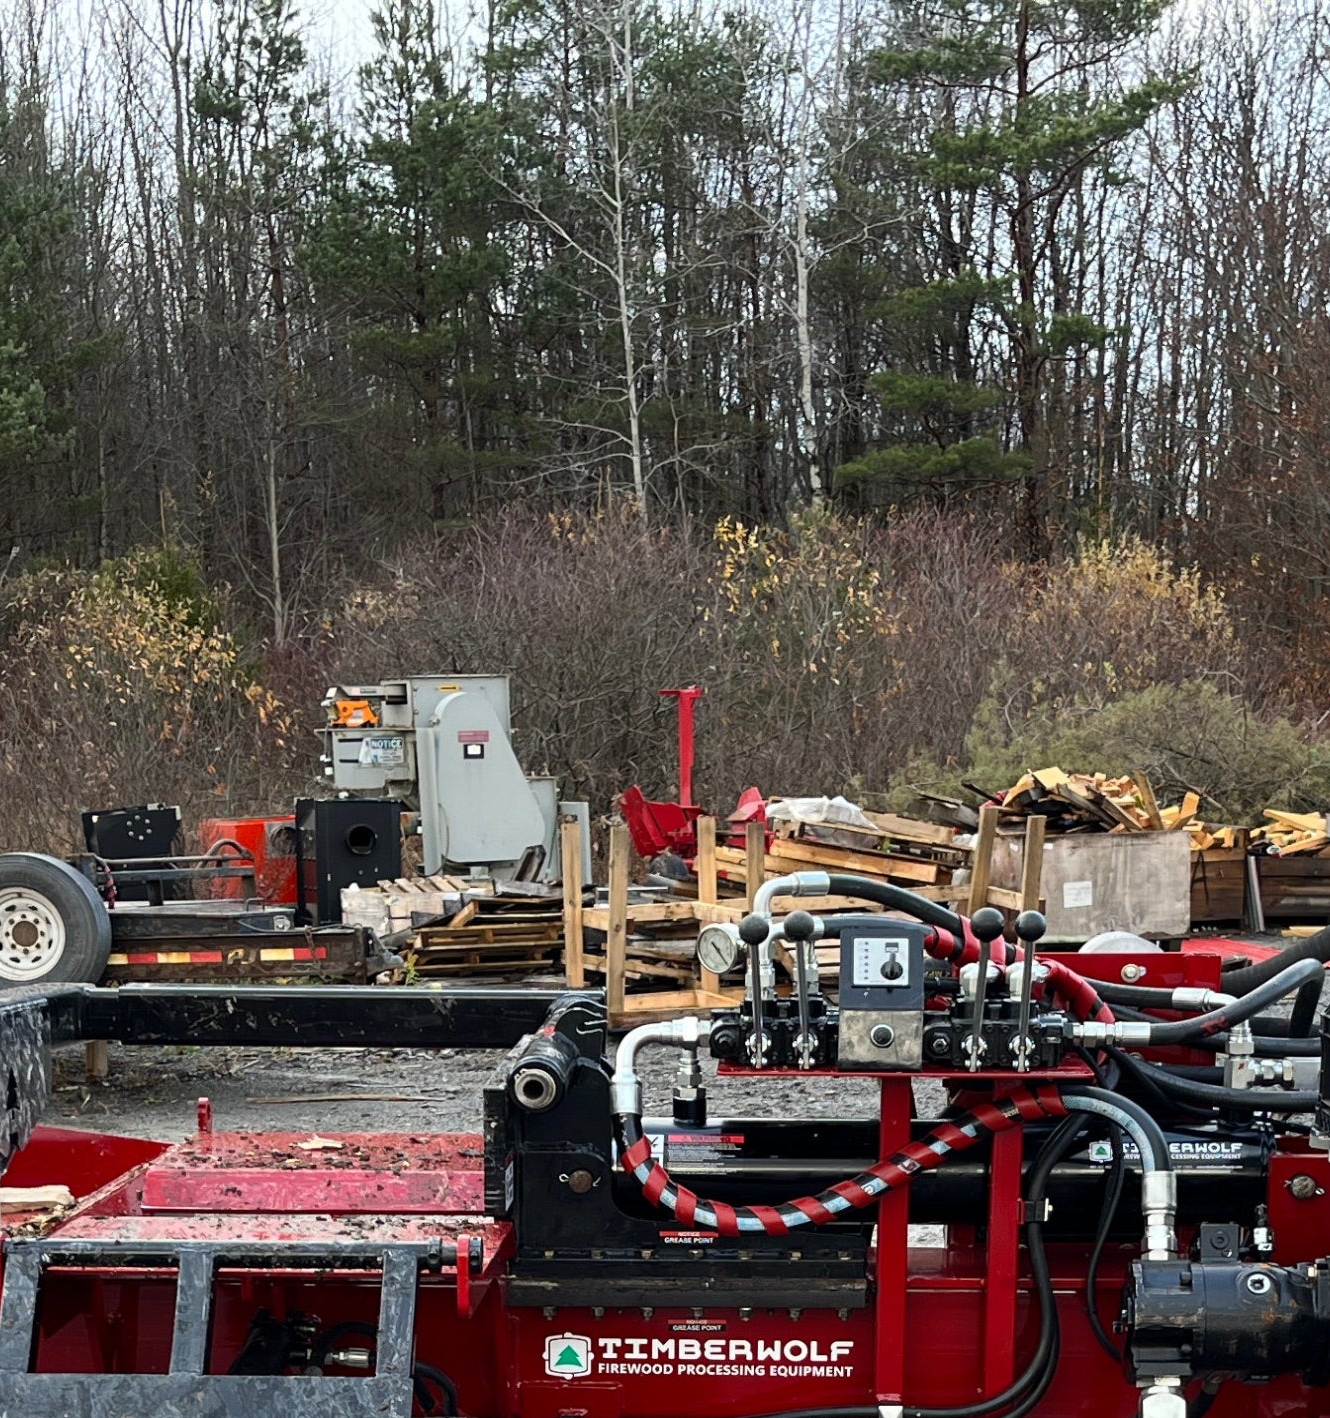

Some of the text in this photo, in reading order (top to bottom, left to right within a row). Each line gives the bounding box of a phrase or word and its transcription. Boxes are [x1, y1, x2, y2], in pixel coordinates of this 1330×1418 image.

[371, 739, 402, 749] NOTICE
[1123, 1143, 1243, 1153] TIERWOLF
[598, 1337, 855, 1362] TIMBERWOLF
[598, 1363, 854, 1378] FIREWOOD PROCESSING EQUIPMENT
